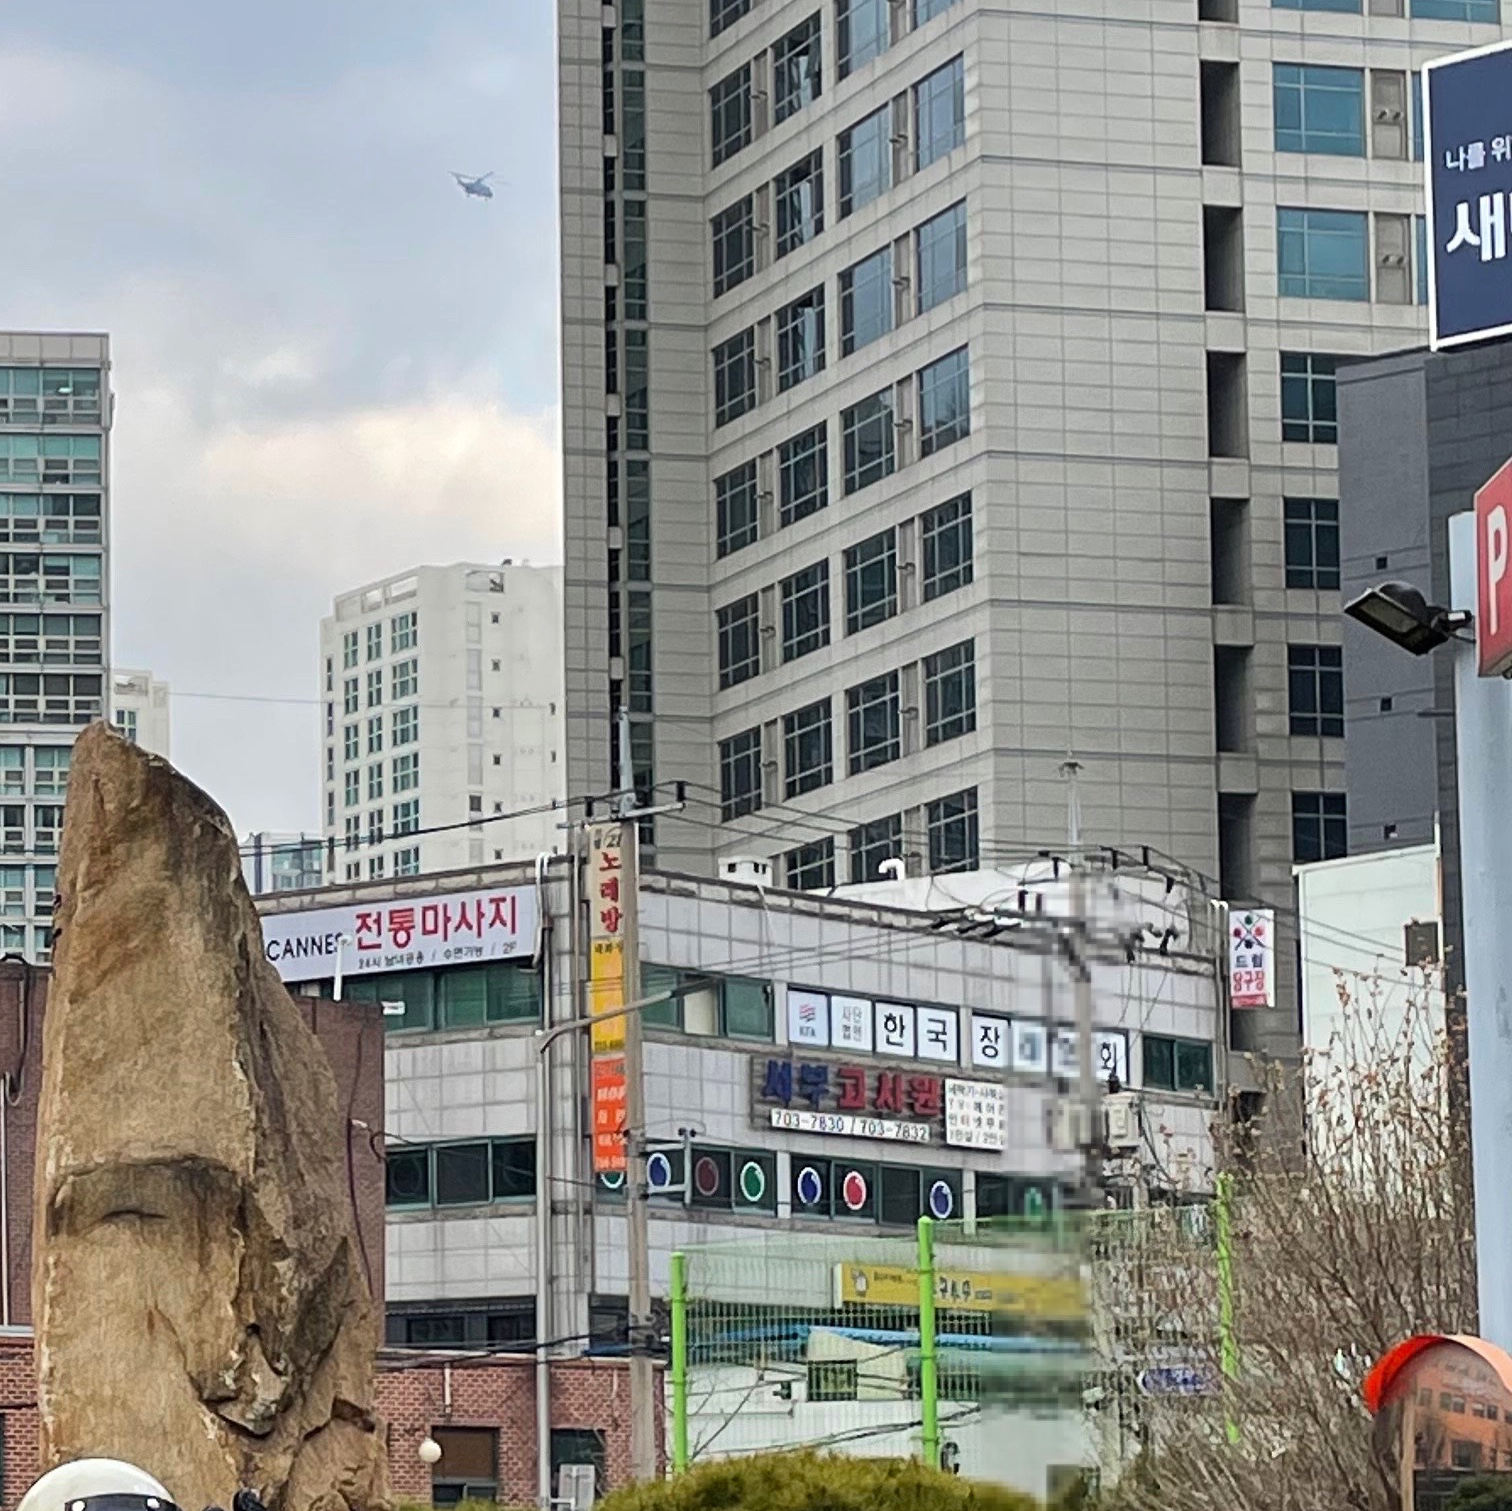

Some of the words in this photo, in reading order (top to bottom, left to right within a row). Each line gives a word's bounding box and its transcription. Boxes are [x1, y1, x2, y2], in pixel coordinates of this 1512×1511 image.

[1445, 141, 1485, 172] 나를
[599, 852, 623, 933] 노래방
[355, 895, 517, 951] 전통마사지
[1234, 971, 1264, 992] 당구장
[773, 1110, 845, 1133] 703-7830
[859, 1117, 928, 1140] 703-7832
